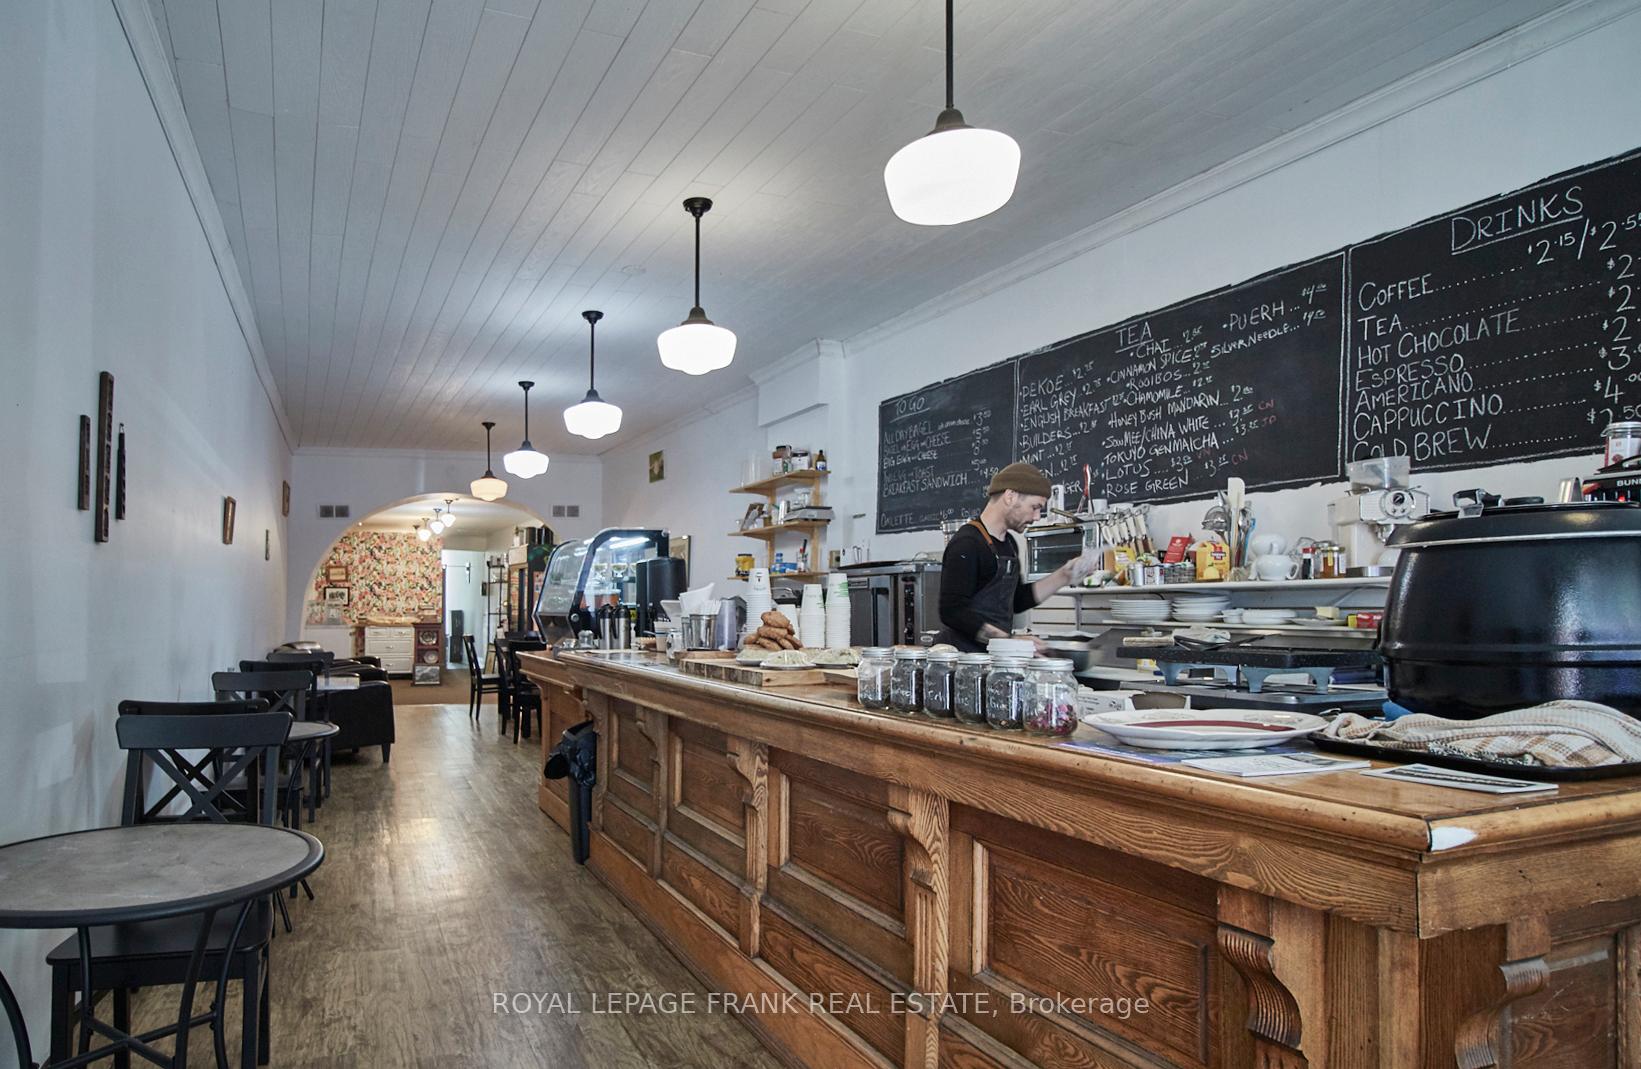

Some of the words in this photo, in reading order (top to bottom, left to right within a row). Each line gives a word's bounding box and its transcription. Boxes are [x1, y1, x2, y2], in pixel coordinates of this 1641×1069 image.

[1451, 186, 1583, 252] DRINKS
[1358, 273, 1434, 311] COFFEE
[1230, 300, 1284, 331] PUERH
[1358, 314, 1402, 340] TEA
[1115, 321, 1152, 347] TEA
[1248, 322, 1290, 347] NEEDLE
[1358, 343, 1391, 368] HOT
[1398, 308, 1521, 358] CHOCOLATE
[1136, 339, 1172, 359] CHAI
[1110, 358, 1157, 383] CINNAMON
[1160, 348, 1193, 369] SPICE
[1355, 353, 1464, 392] ESPRESSO
[1022, 374, 1064, 402] PEKOE
[1130, 369, 1182, 391] ROOIBOS
[1354, 372, 1474, 414] AMERICANO
[1126, 385, 1183, 406] CHAMOMILE
[1167, 389, 1220, 417] MANDARIN
[1179, 415, 1209, 435] WHITE
[1353, 393, 1503, 441] CAPPUCCINO
[1022, 427, 1072, 453] BUILDERS
[1149, 432, 1220, 457] GENMAICHA
[1414, 424, 1491, 462] BREW
[920, 473, 968, 492] SANDWICH
[1105, 458, 1153, 481] LOTUS
[1106, 482, 1138, 498] ROSE
[1145, 468, 1189, 494] GREEN
